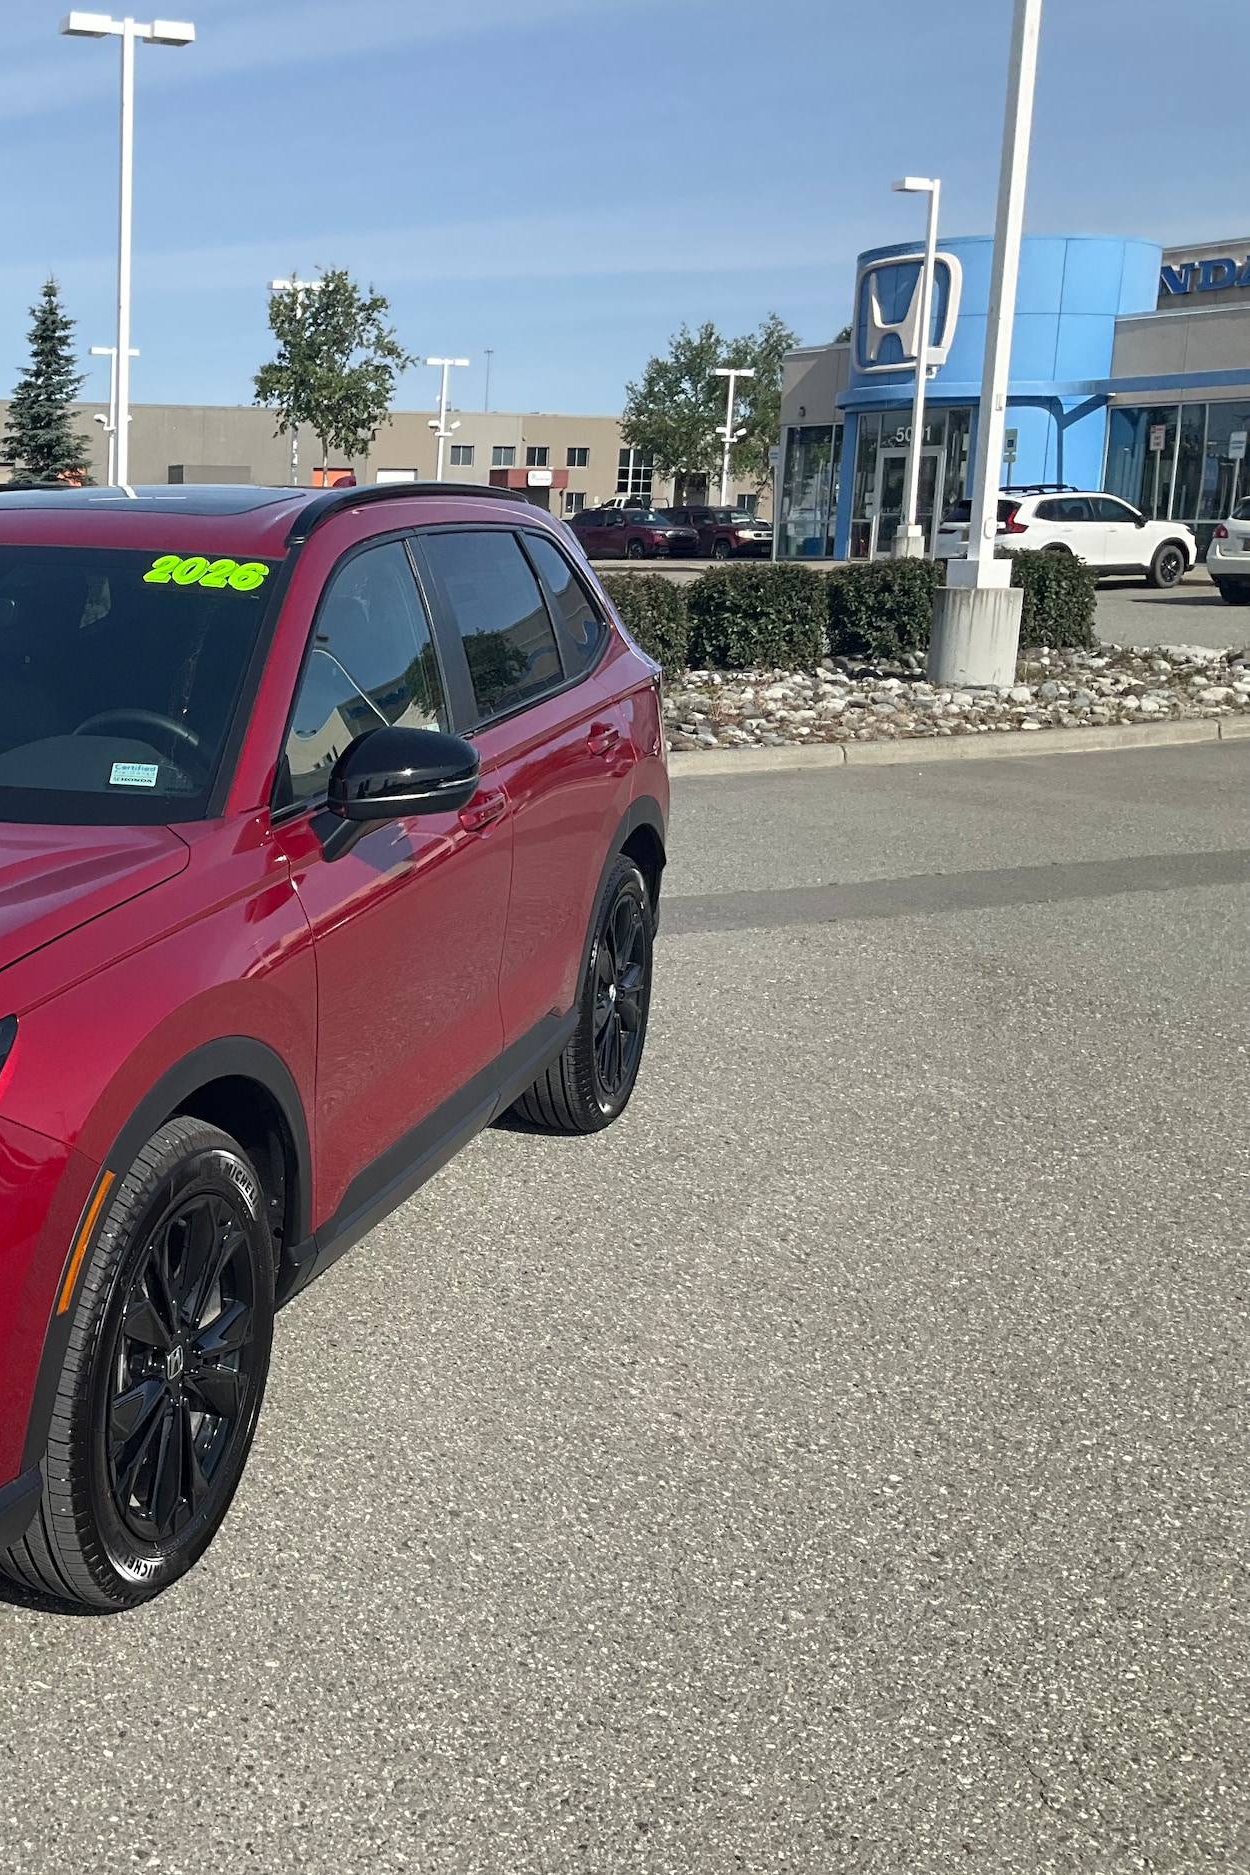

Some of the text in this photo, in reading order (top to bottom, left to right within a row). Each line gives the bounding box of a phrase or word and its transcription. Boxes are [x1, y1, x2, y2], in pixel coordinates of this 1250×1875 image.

[896, 425, 931, 442] 501
[143, 554, 270, 591] 2026
[115, 764, 156, 772] Certified
